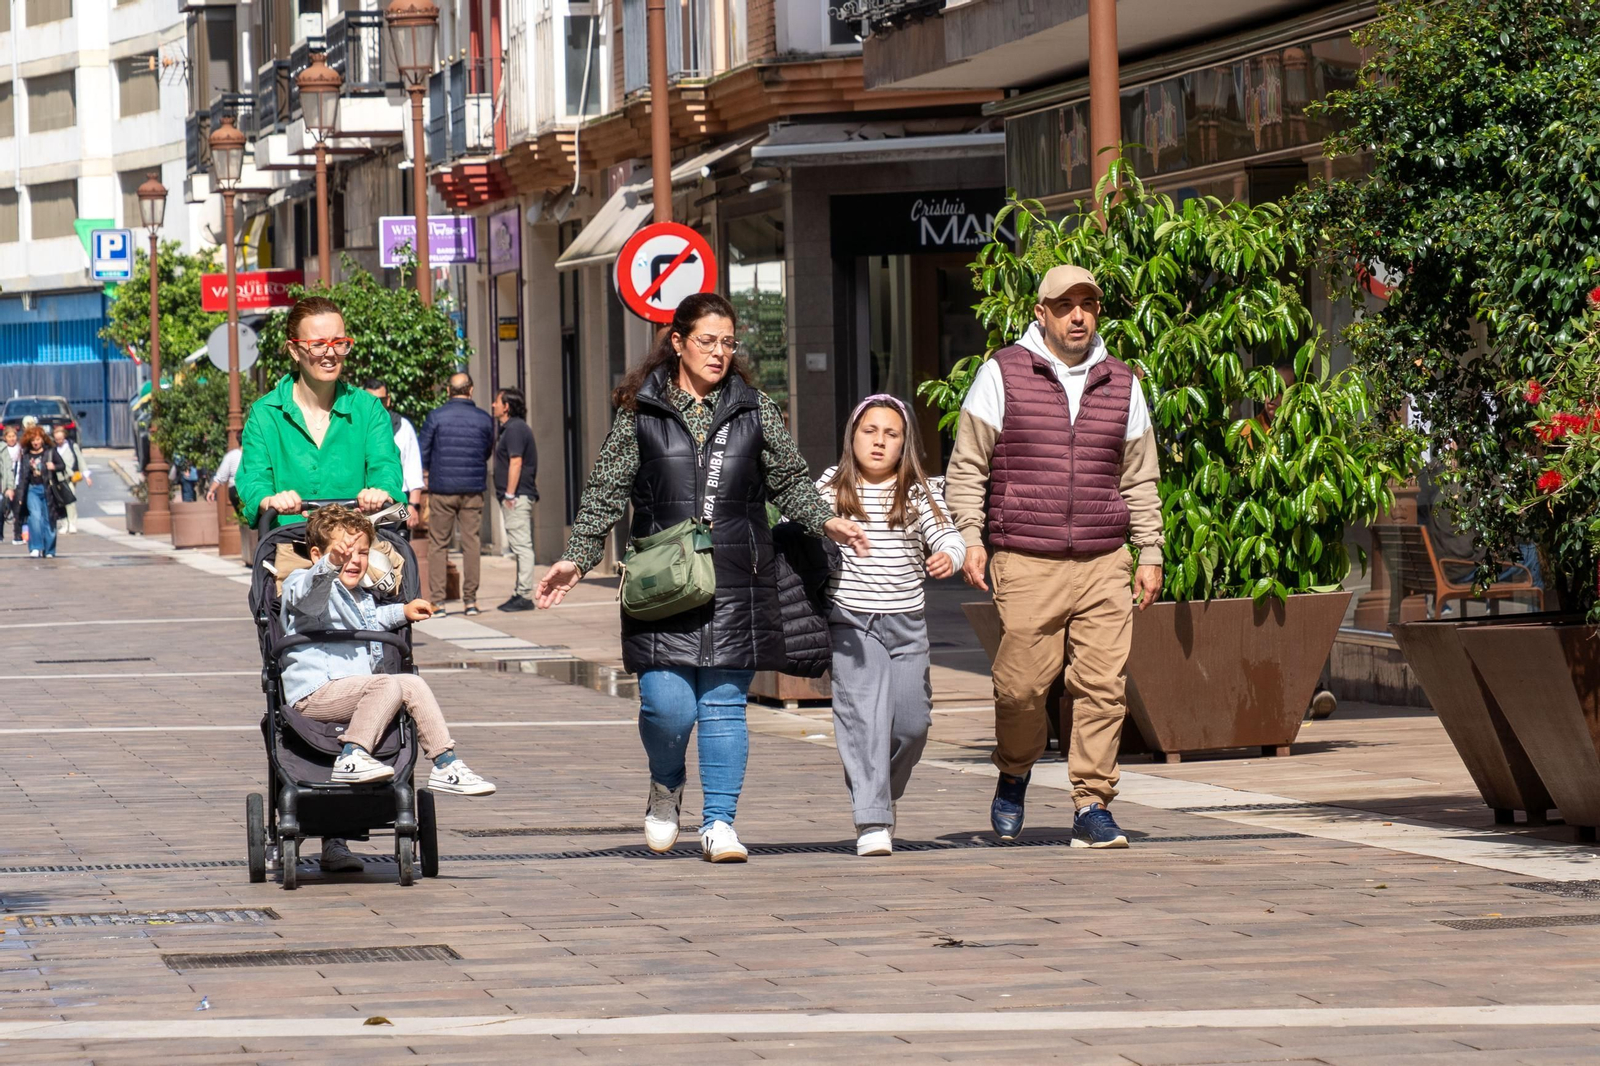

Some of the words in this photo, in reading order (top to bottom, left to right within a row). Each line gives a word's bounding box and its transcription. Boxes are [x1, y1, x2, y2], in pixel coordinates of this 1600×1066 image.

[911, 198, 966, 221] Crisluis
[101, 234, 123, 259] P
[211, 282, 292, 299] VAQUERO
[707, 451, 725, 488] BIMBA
